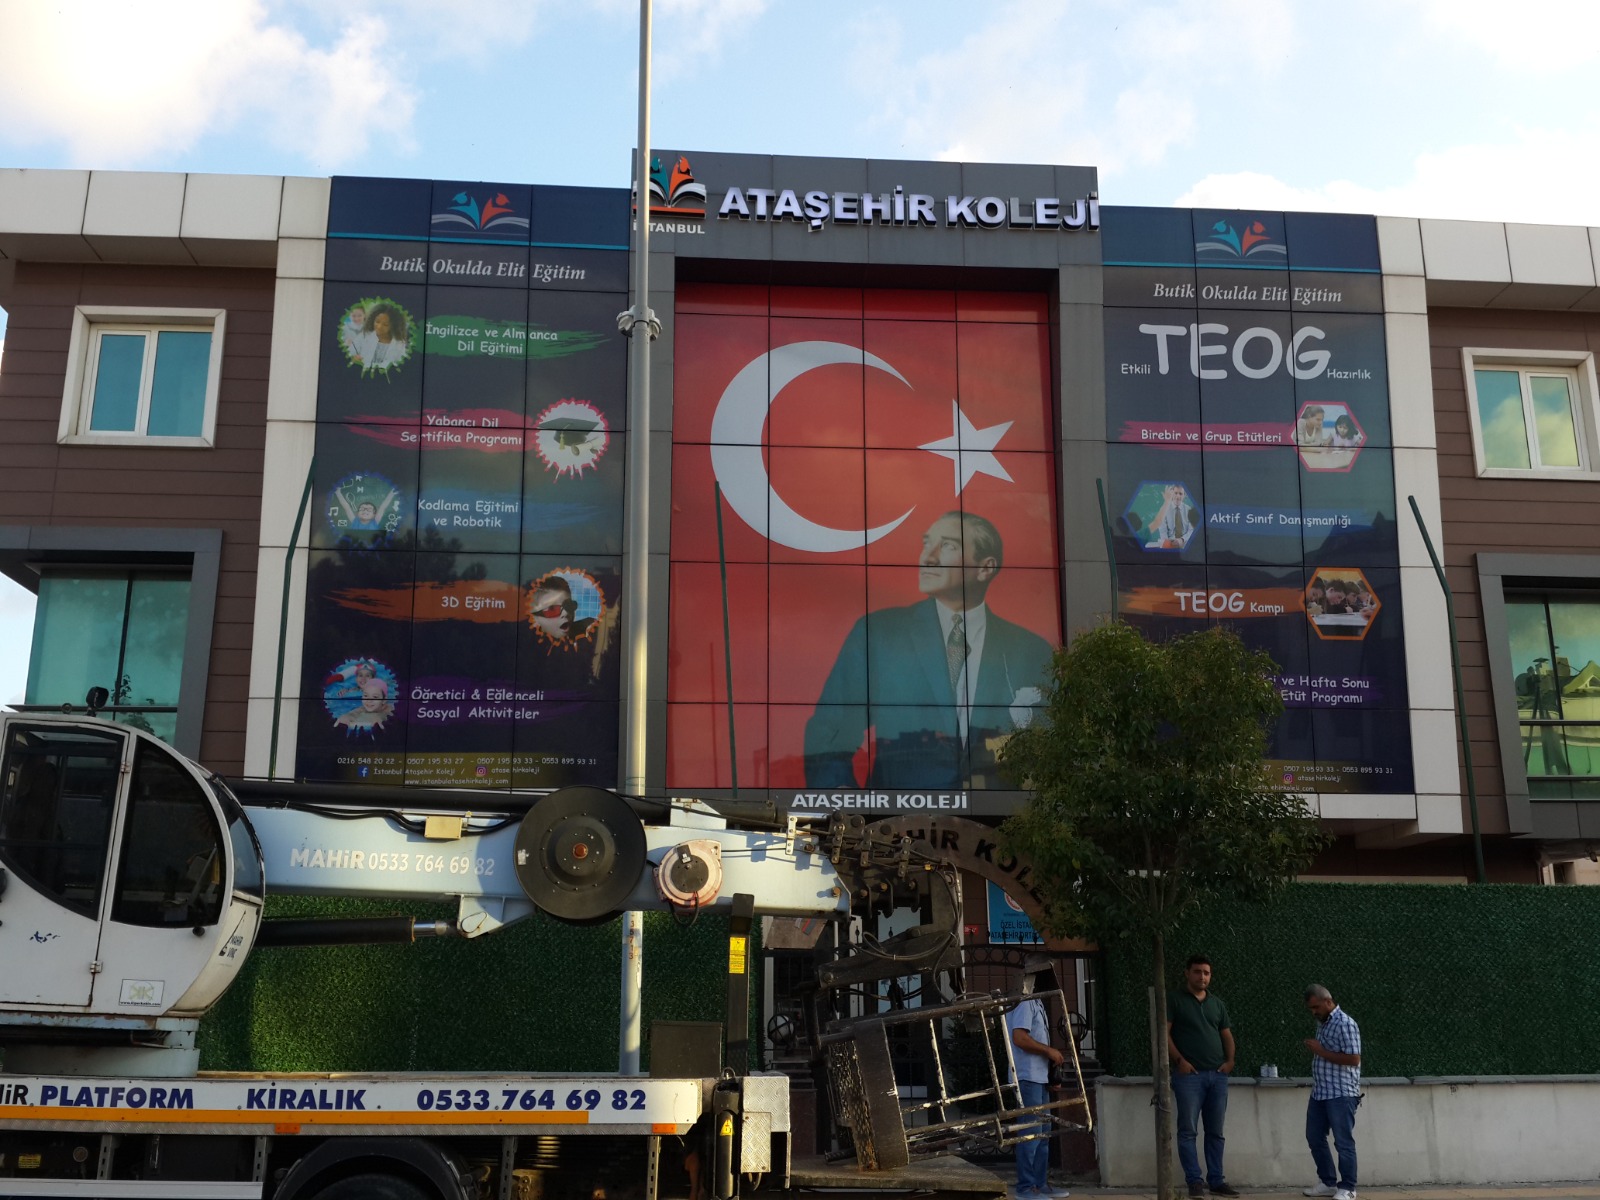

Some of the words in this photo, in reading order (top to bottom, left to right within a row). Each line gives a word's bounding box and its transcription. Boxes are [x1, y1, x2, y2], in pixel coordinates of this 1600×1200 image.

[717, 184, 937, 232] ATAŞEHİR
[945, 190, 1099, 231] KOLEJİ
[633, 219, 705, 235] İTANBUL
[380, 256, 425, 273] Butik
[432, 258, 492, 277] Okulda
[496, 261, 525, 278] Elit
[532, 263, 586, 283] Eğitim
[1153, 283, 1195, 299] Butik
[1201, 285, 1257, 301] Okulda
[1261, 286, 1288, 302] Elit
[1293, 287, 1342, 305] Eğitim
[424, 322, 479, 339] İngilizce
[485, 328, 499, 338] ve
[502, 327, 558, 342] Almanca
[457, 339, 474, 352] Dil
[479, 340, 523, 355] Eğitimi
[1121, 363, 1151, 375] Etkili
[1138, 322, 1332, 380] TEOG
[1327, 369, 1372, 380] Hazırlık
[426, 414, 476, 428] Yabancı
[482, 416, 499, 429] Dil
[400, 430, 462, 443] Sertifika
[465, 431, 523, 447] Programı
[1141, 428, 1181, 441] Birebir
[1186, 432, 1199, 441] ve
[1204, 431, 1233, 445] Grup
[1237, 430, 1282, 443] Etütleri
[417, 498, 470, 513] Kodlama
[475, 500, 520, 515] Eğitimi
[433, 516, 449, 527] ve
[453, 514, 503, 528] Robotik
[1210, 511, 1241, 524] Aktif
[1246, 512, 1274, 525] Sınıf
[1279, 514, 1351, 529] Danışmanlığı
[441, 596, 459, 608] 3D
[465, 596, 506, 611] Eğitim
[1174, 591, 1245, 614] TEOG
[1250, 602, 1285, 615] Kampı
[1281, 677, 1295, 687] ve
[1300, 675, 1337, 689] Hafta
[1341, 677, 1370, 689] Sonu
[411, 686, 466, 702] Öğretici
[471, 688, 481, 700] &
[486, 687, 545, 702] Eğlenceli
[1281, 689, 1307, 702] Etüt
[1312, 690, 1363, 706] Programı
[417, 706, 460, 721] Sosyal
[468, 706, 540, 721] Aktiviteler
[337, 757, 356, 765] 0216
[373, 757, 383, 765] 20
[385, 757, 395, 765] 22
[406, 757, 425, 765] 0507
[454, 757, 464, 765] 27
[791, 790, 890, 811] ATAŞEHİR
[896, 791, 968, 810] KOLEJİ
[368, 852, 410, 871] 0533
[415, 854, 444, 873] 764
[450, 856, 470, 875] 69
[474, 858, 495, 876] 82
[991, 930, 1019, 940] ATAEHİR
[40, 1085, 194, 1109] PLATFORM
[416, 1088, 490, 1111] 0533
[501, 1088, 555, 1111] 764
[565, 1088, 602, 1111] 69
[610, 1088, 646, 1111] 82
